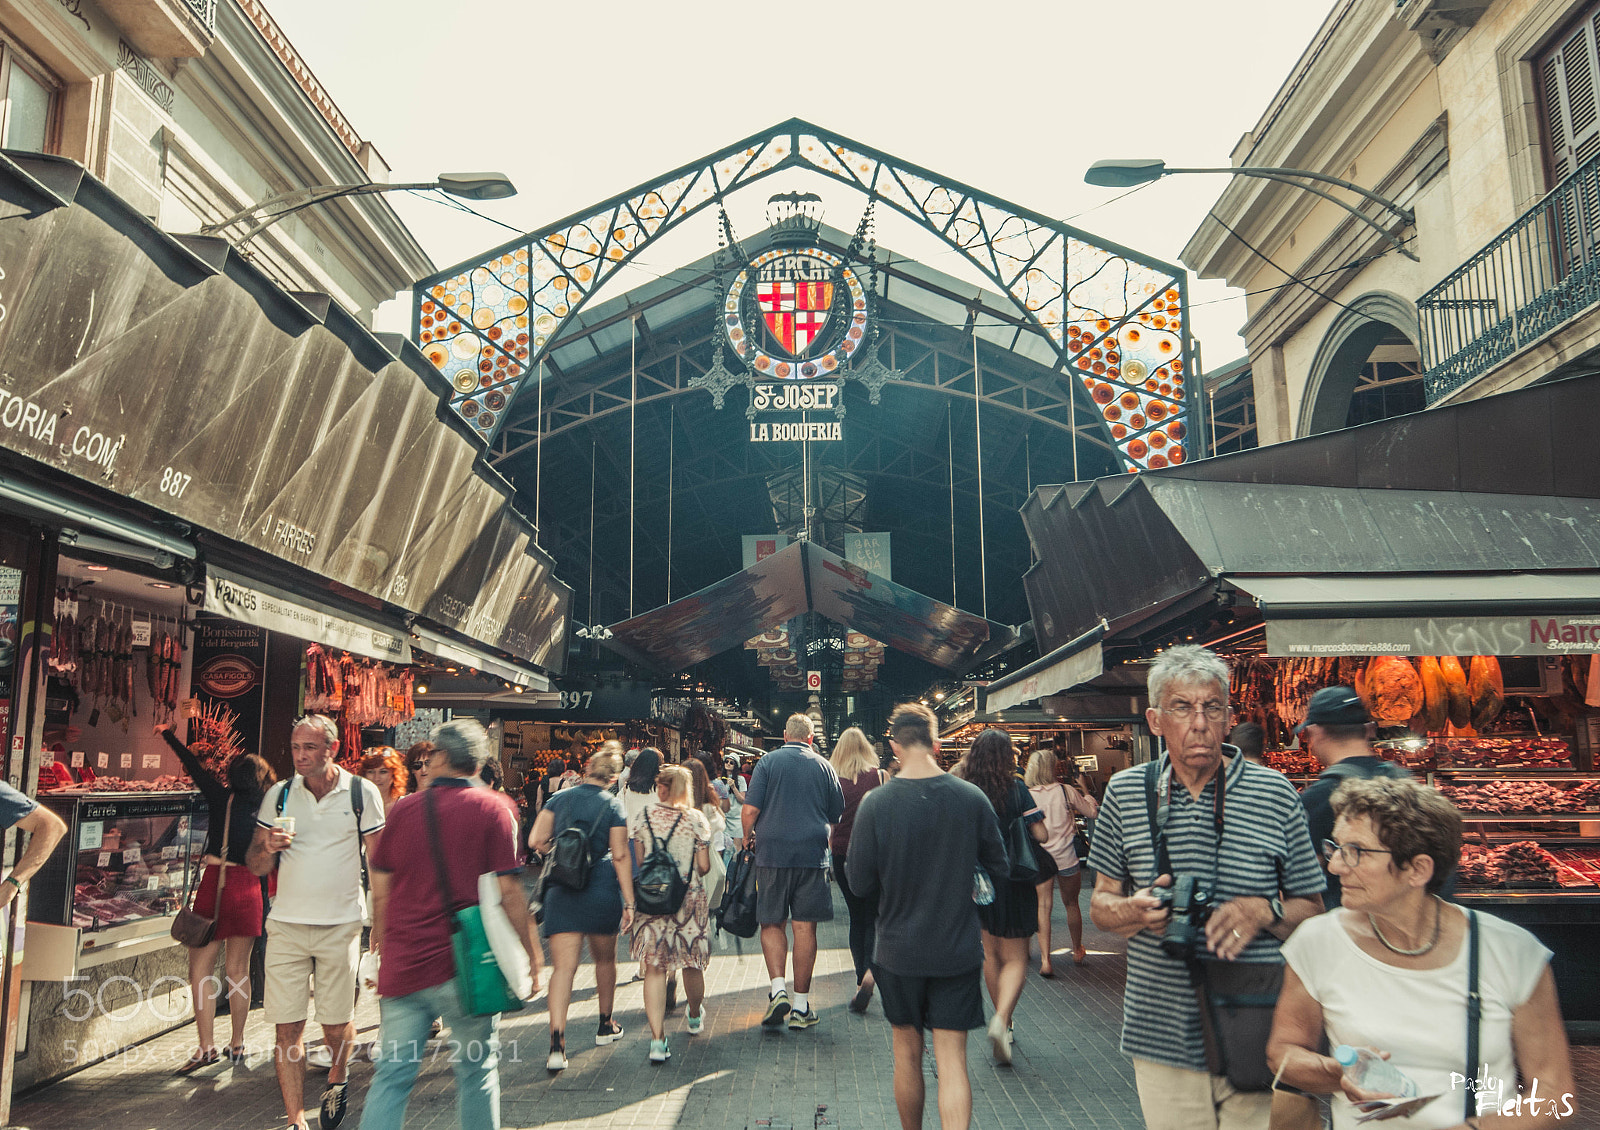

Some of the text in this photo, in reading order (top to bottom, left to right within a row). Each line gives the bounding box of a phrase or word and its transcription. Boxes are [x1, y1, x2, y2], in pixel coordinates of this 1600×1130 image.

[773, 384, 838, 409] JOSEP
[750, 422, 843, 442] LA BOQUERIA
[160, 467, 192, 498] 887
[260, 514, 273, 537] J
[1289, 641, 1411, 653] www.marcosboqueria886.com
[811, 676, 818, 686] 6
[560, 690, 593, 710] 897
